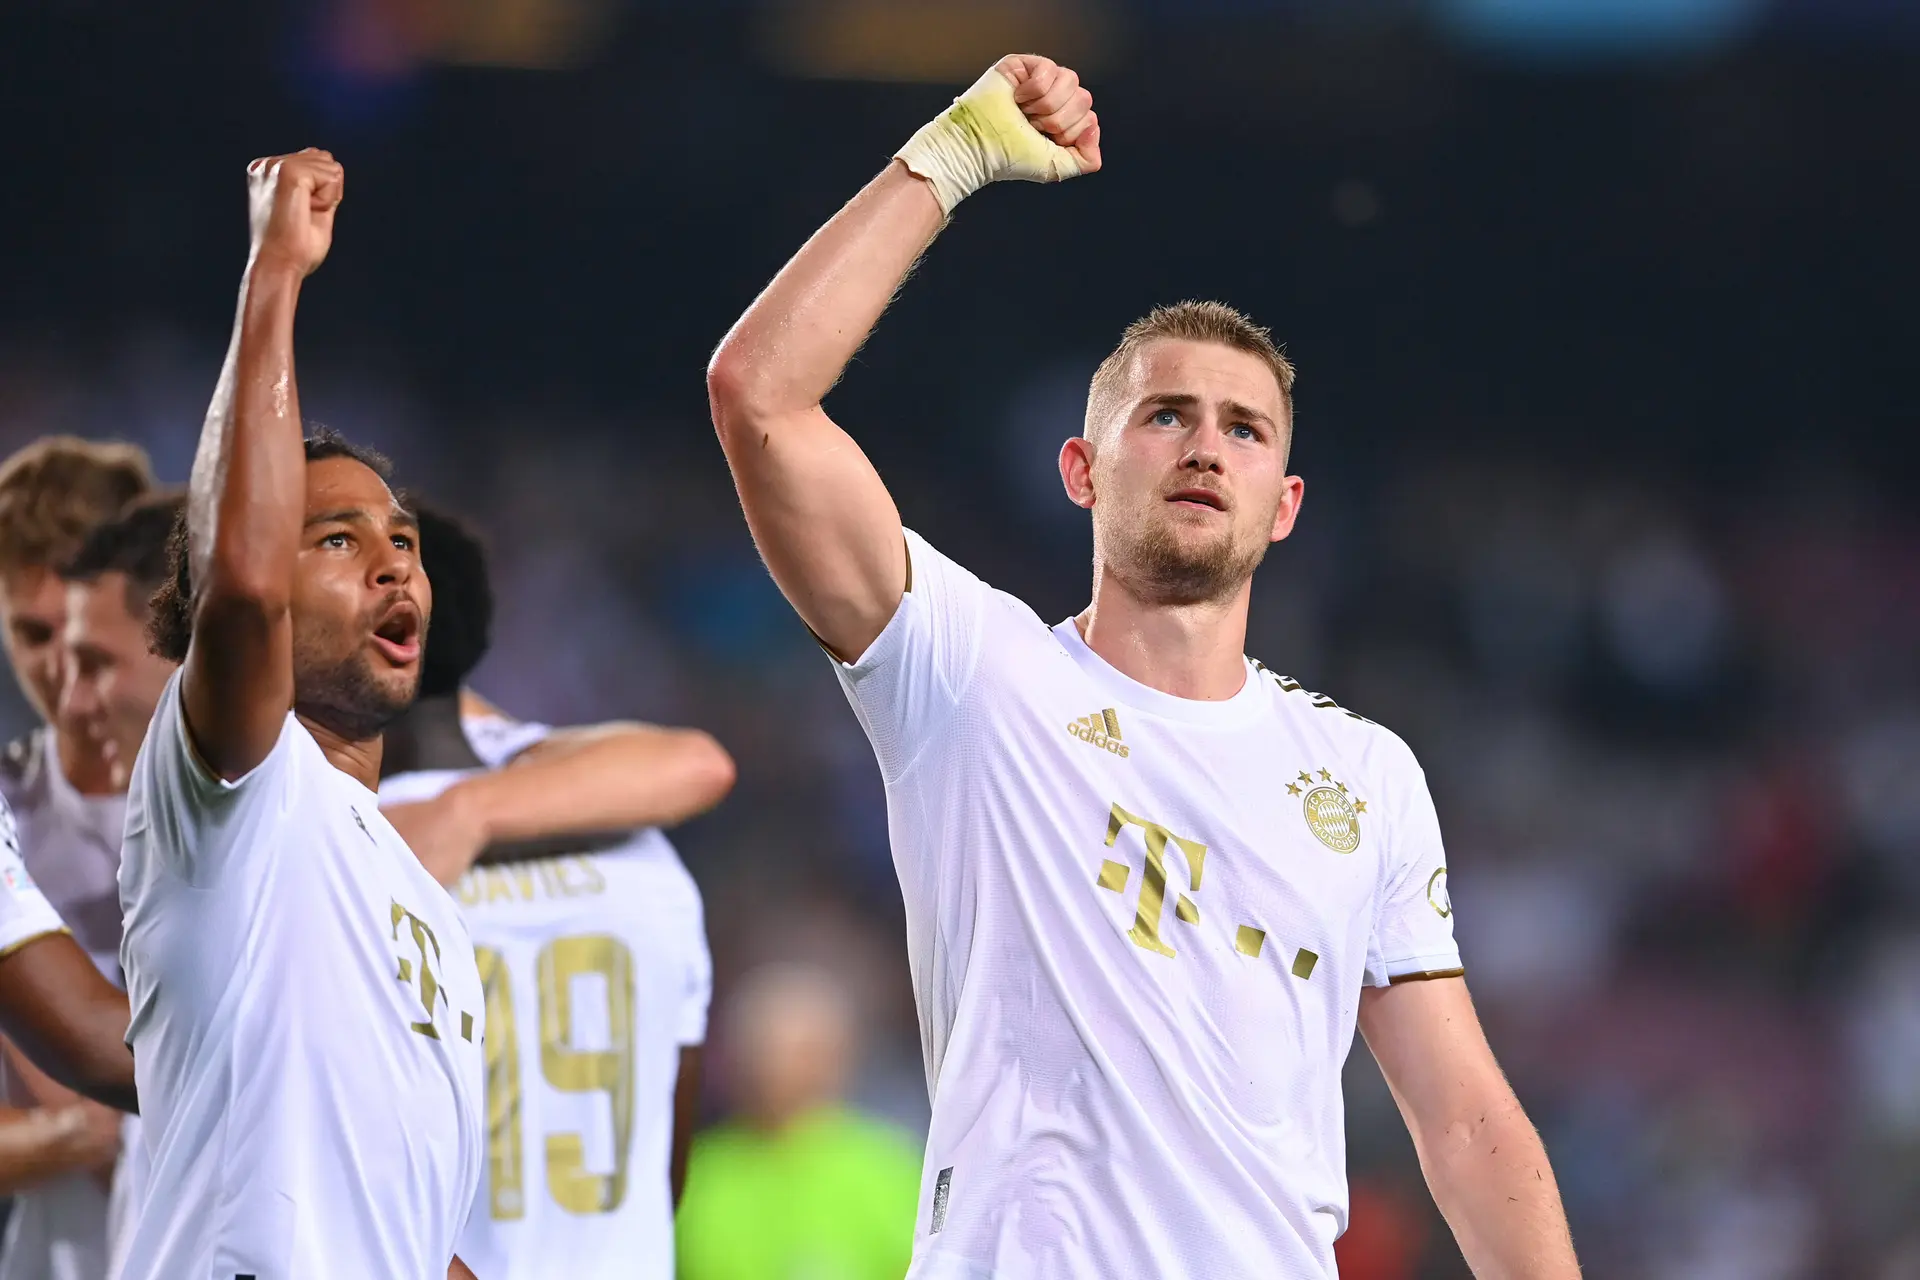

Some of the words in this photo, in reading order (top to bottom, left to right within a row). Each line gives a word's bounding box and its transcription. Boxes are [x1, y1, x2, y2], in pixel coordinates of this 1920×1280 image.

[1066, 721, 1129, 758] adidas
[1309, 797, 1319, 811] FC
[1318, 792, 1355, 820] BAYERN
[474, 933, 637, 1221] 19
